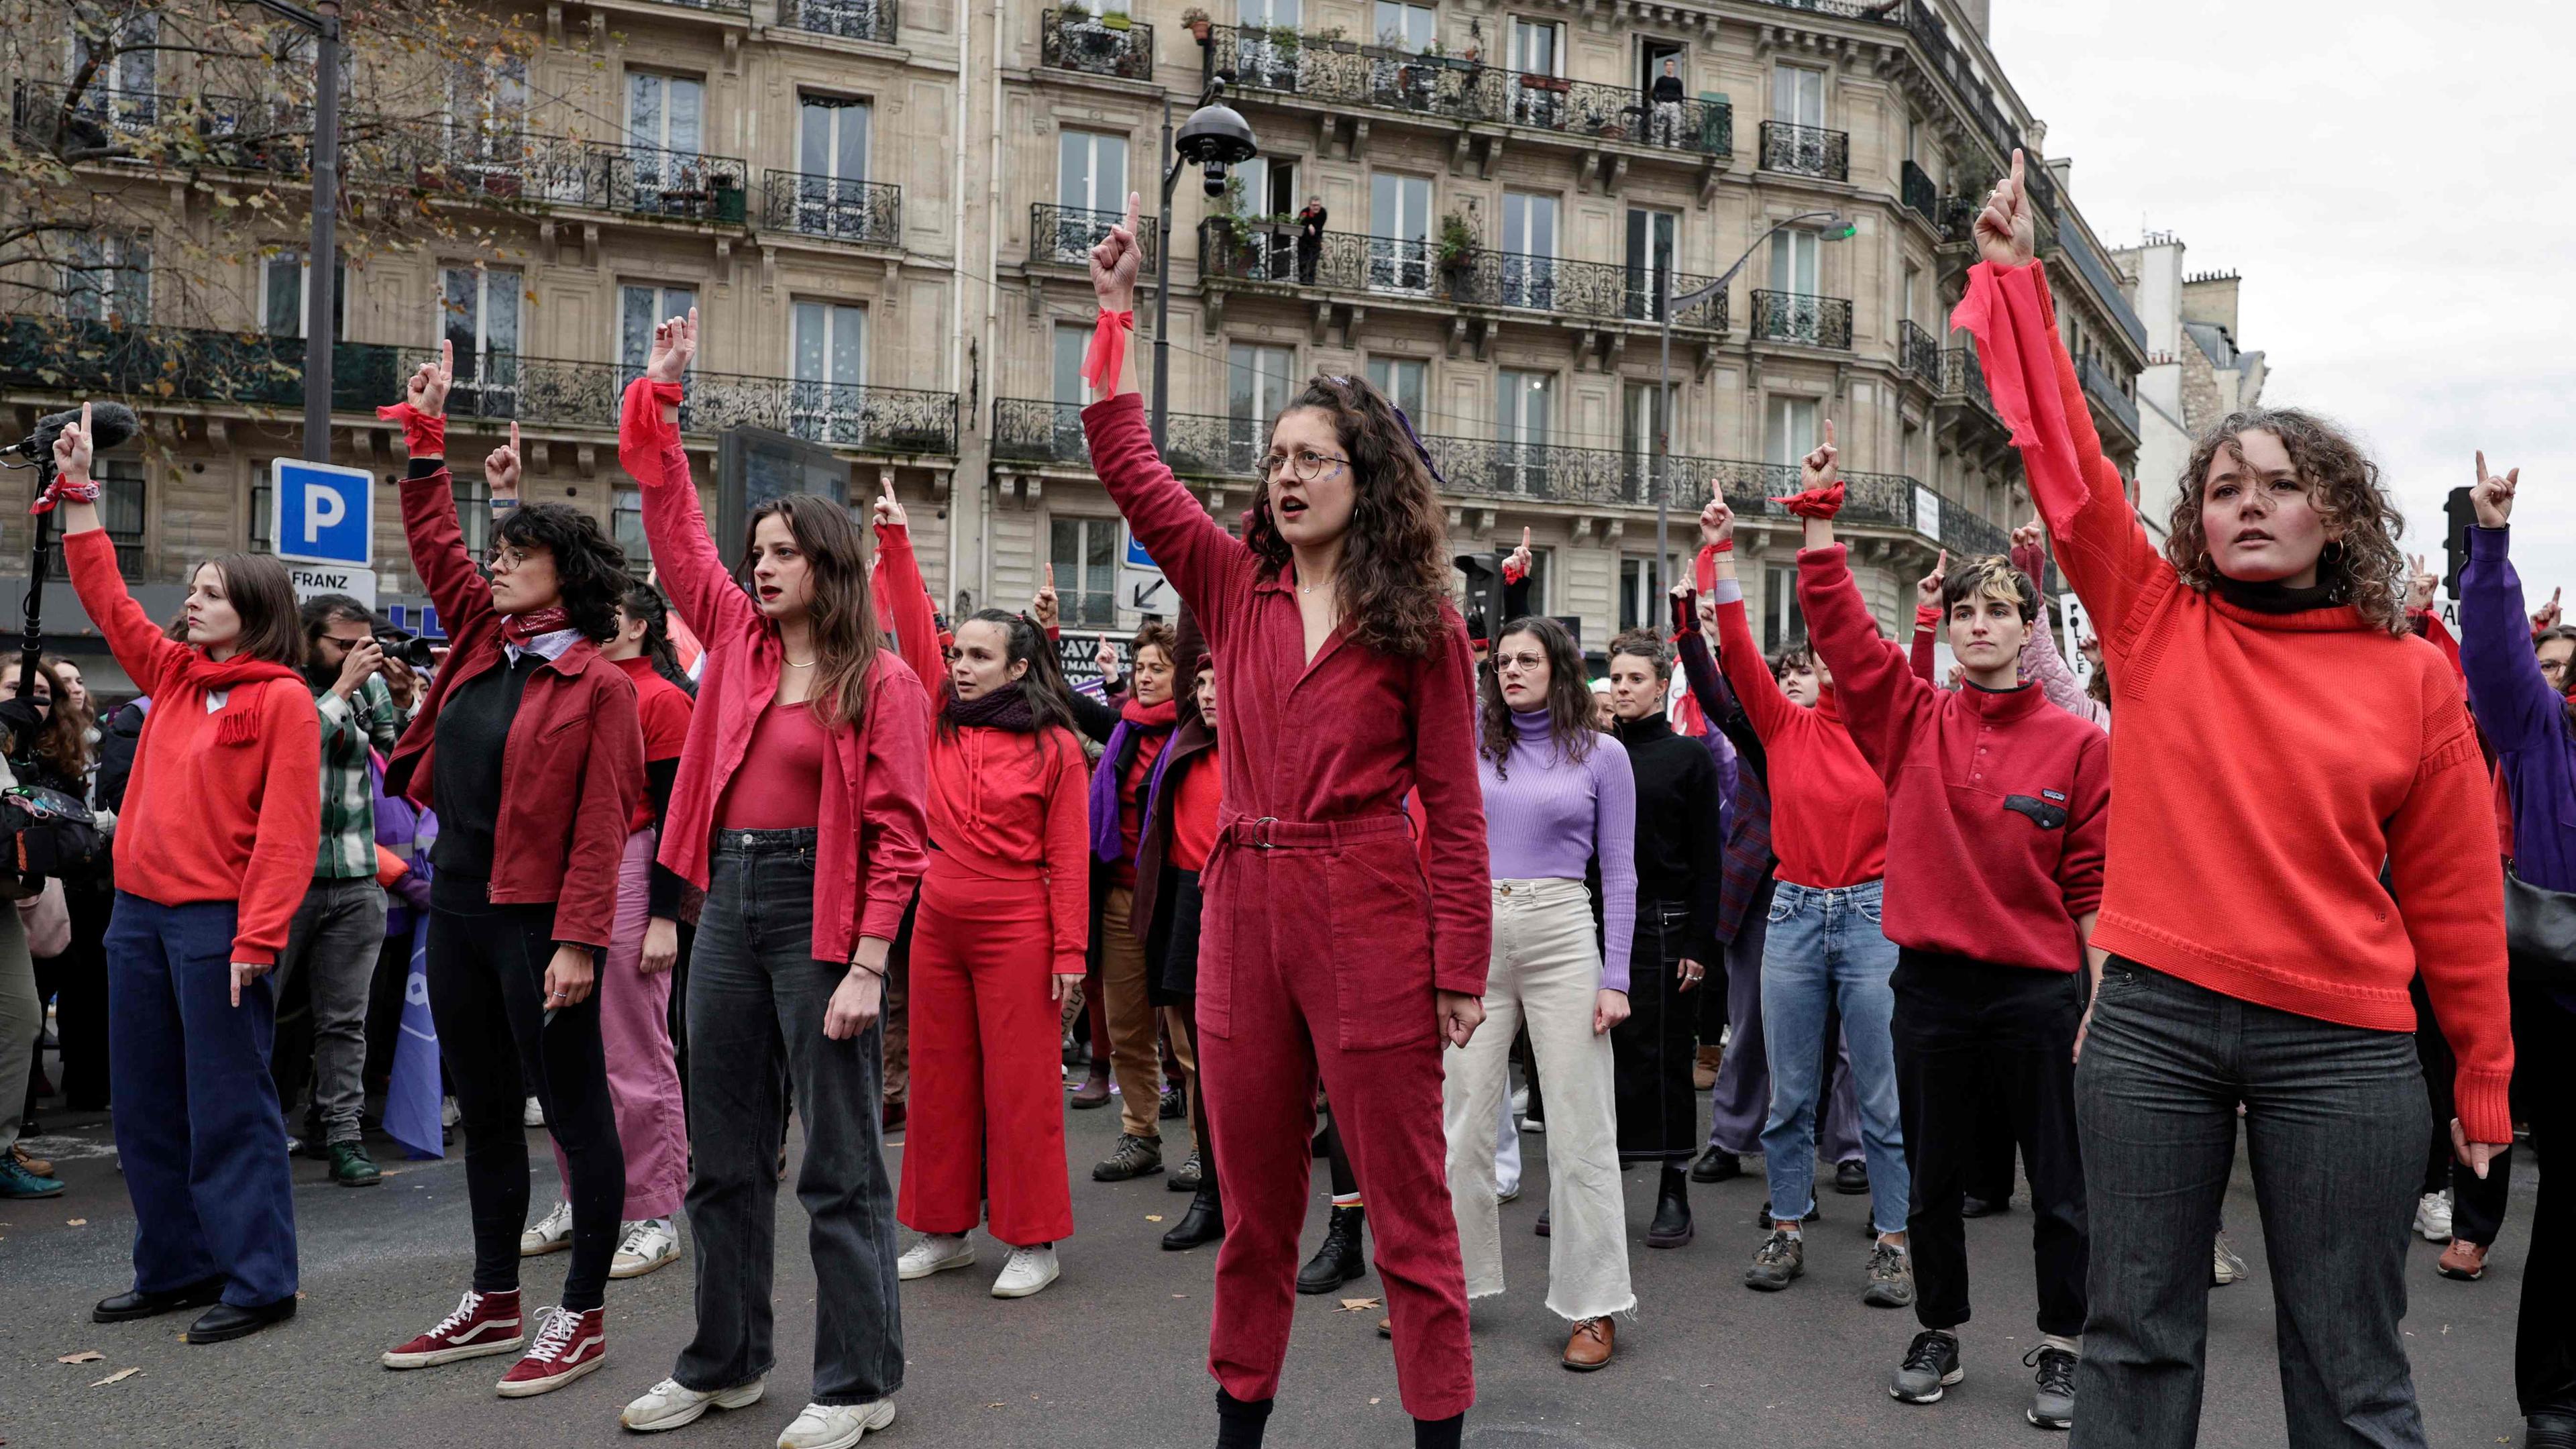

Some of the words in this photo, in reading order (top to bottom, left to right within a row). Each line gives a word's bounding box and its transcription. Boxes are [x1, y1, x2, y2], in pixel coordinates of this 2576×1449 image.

[304, 484, 345, 543] P
[292, 572, 347, 589] FRANZ
[2070, 604, 2084, 674] POLICE
